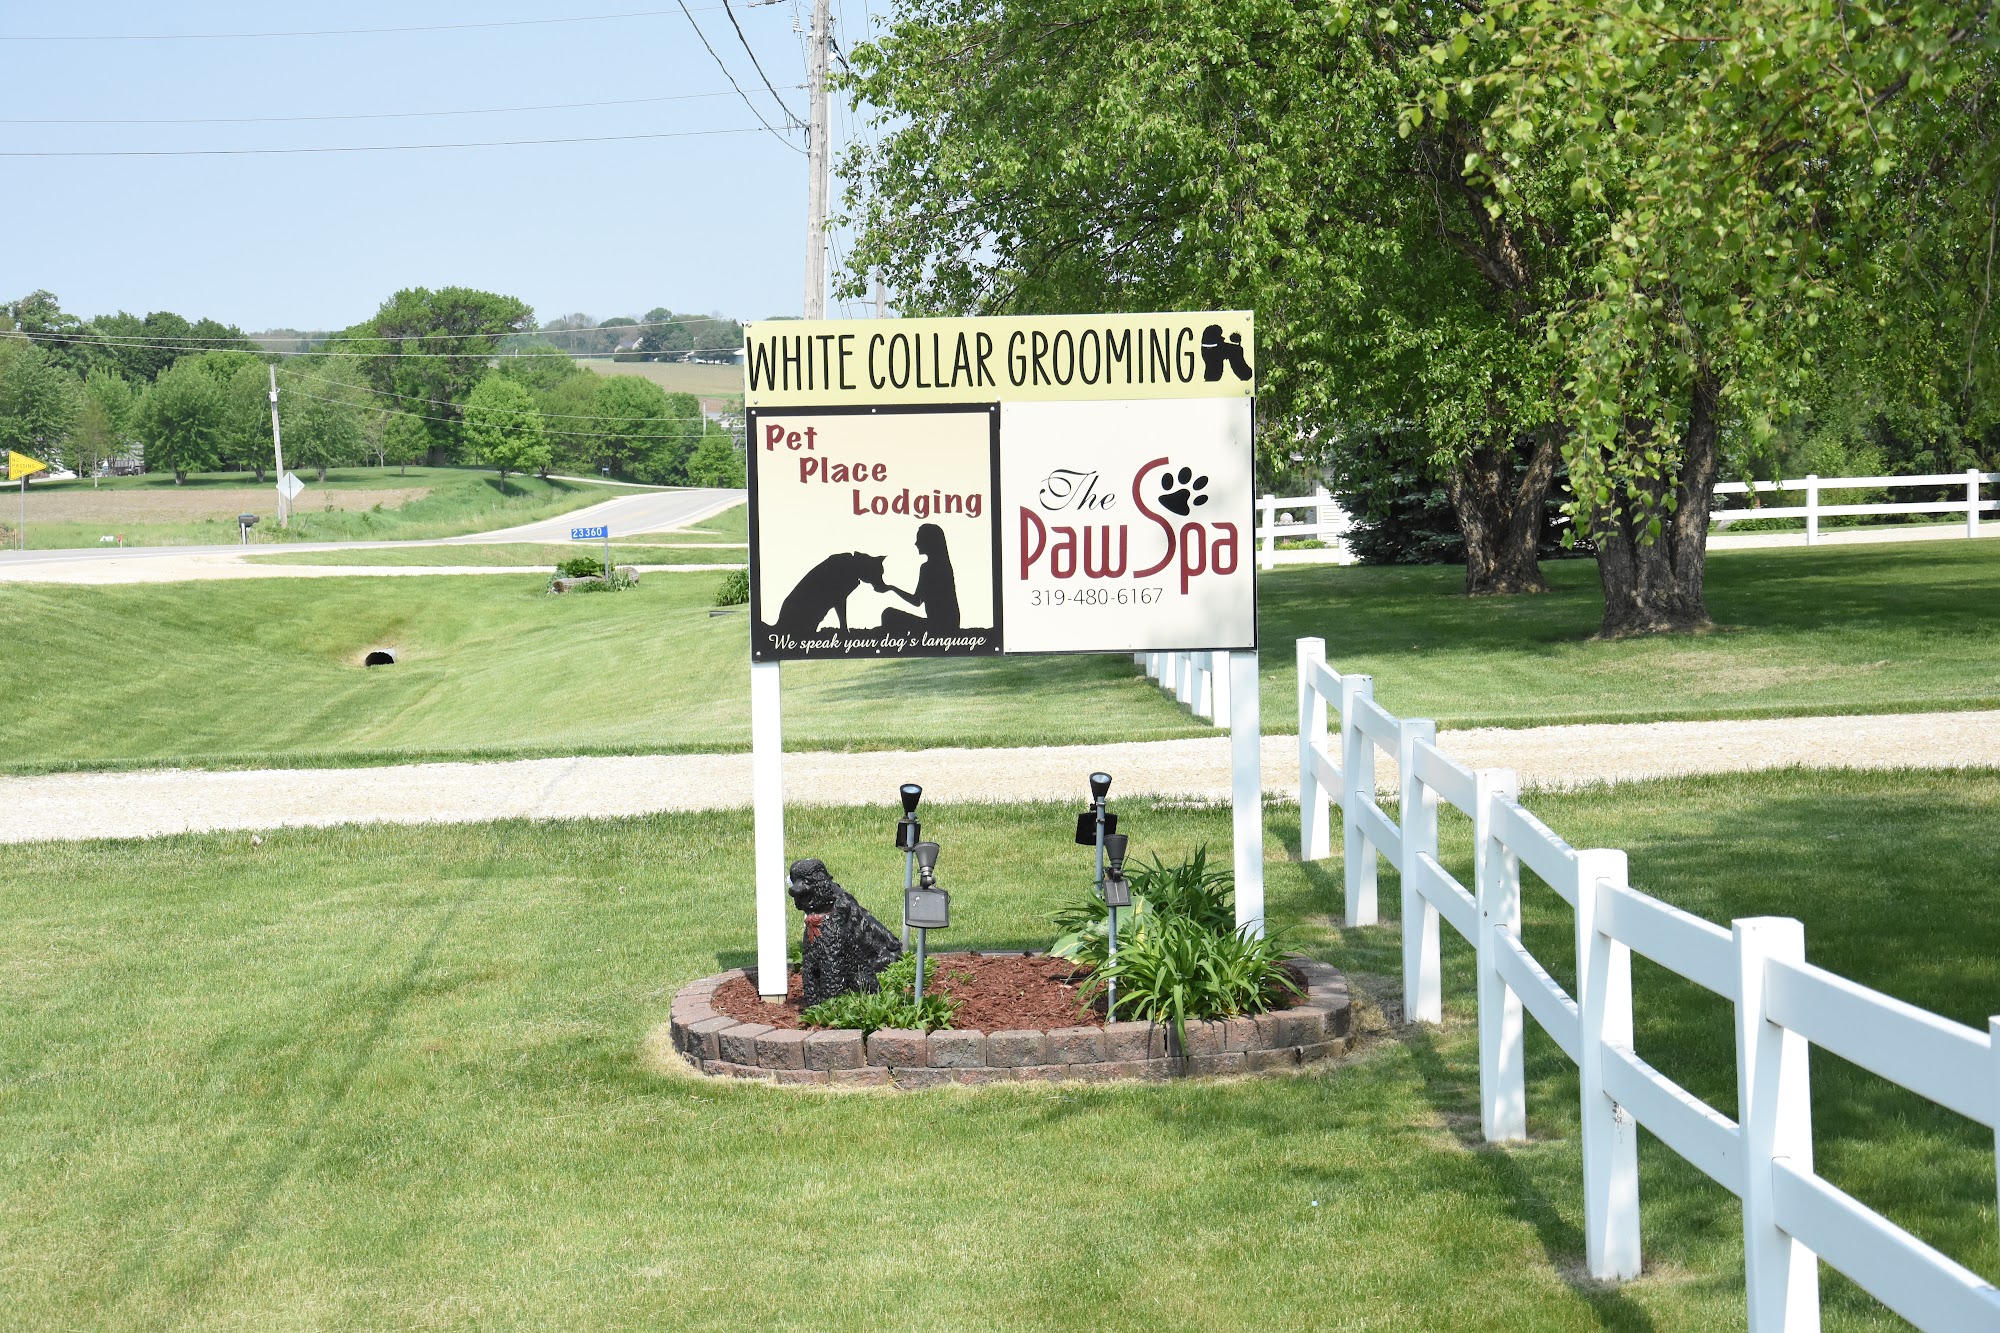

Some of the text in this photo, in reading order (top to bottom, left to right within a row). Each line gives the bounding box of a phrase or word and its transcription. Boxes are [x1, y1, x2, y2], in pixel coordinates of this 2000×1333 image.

[746, 327, 1195, 391] WHITE COLLAR GROOMING
[765, 424, 818, 451] Pet
[799, 456, 888, 484] Place
[852, 488, 983, 519] Lodging
[1039, 469, 1117, 511] The
[572, 527, 603, 538] 23360
[1031, 588, 1164, 606] 319-480-6167
[768, 631, 987, 654] We speak your dog's language
